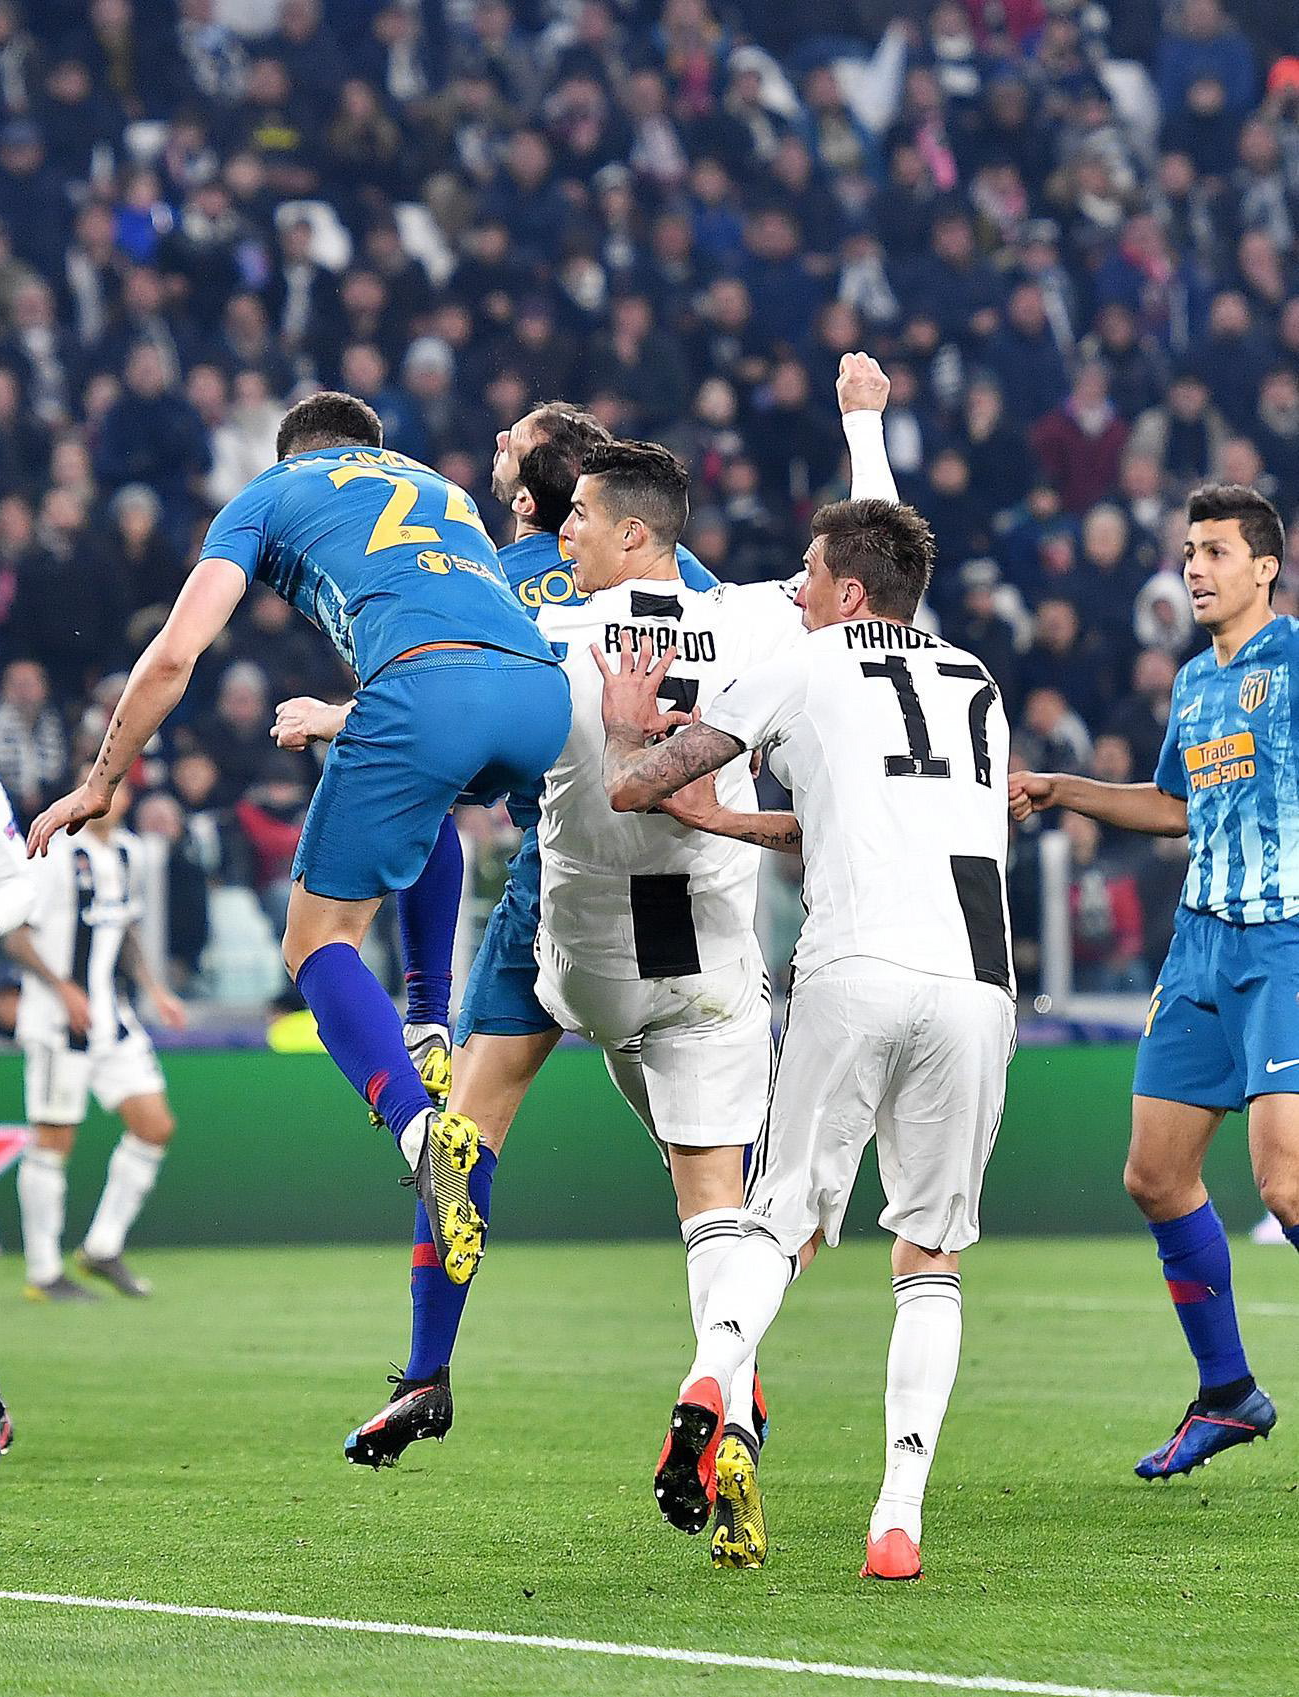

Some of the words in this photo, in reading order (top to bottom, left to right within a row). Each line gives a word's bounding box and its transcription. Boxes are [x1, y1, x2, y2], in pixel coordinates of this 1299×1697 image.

[860, 655, 998, 788] 17
[1198, 740, 1235, 763] Trade
[1190, 760, 1256, 793] Plus500
